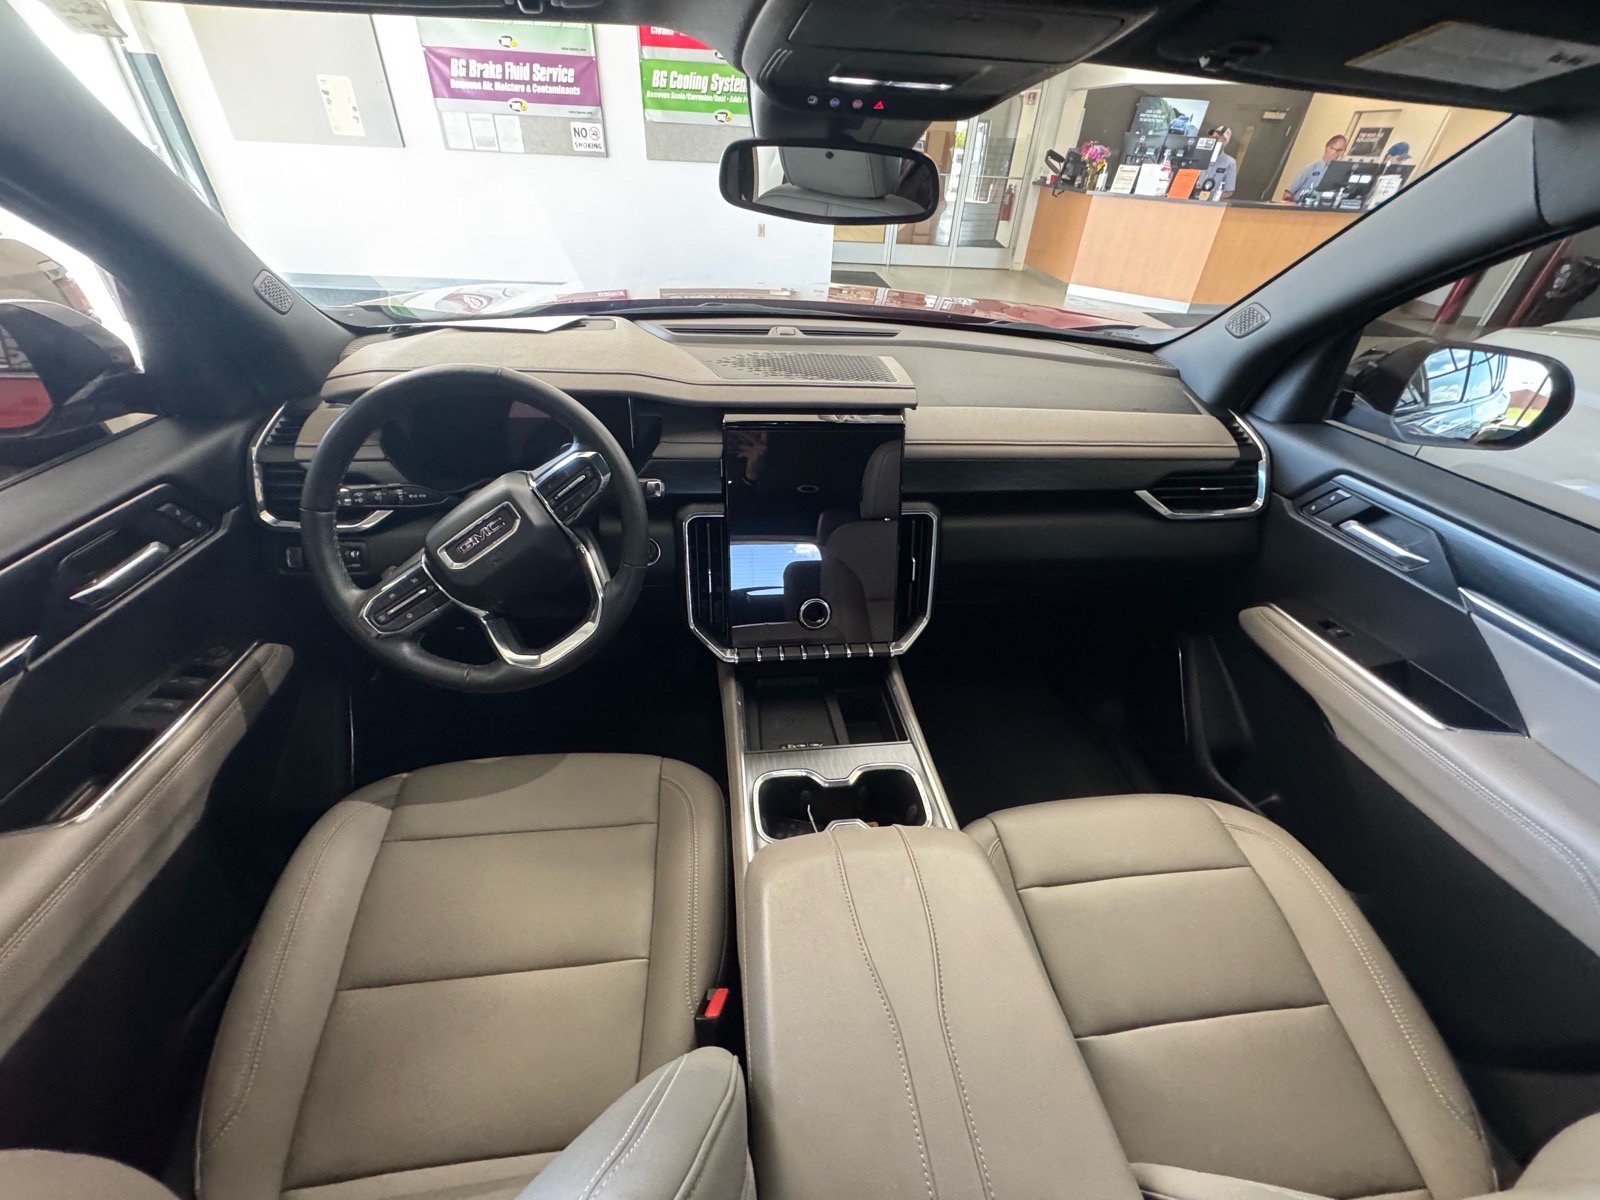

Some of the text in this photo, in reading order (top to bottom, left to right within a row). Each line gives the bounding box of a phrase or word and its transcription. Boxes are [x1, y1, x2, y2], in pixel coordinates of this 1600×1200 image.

[450, 58, 575, 83] BG Brake Fluid Service
[652, 69, 668, 88] BG
[669, 70, 709, 94] Cooling
[573, 126, 588, 138] NO
[574, 141, 603, 150] SMOKING
[456, 517, 506, 554] GMC
